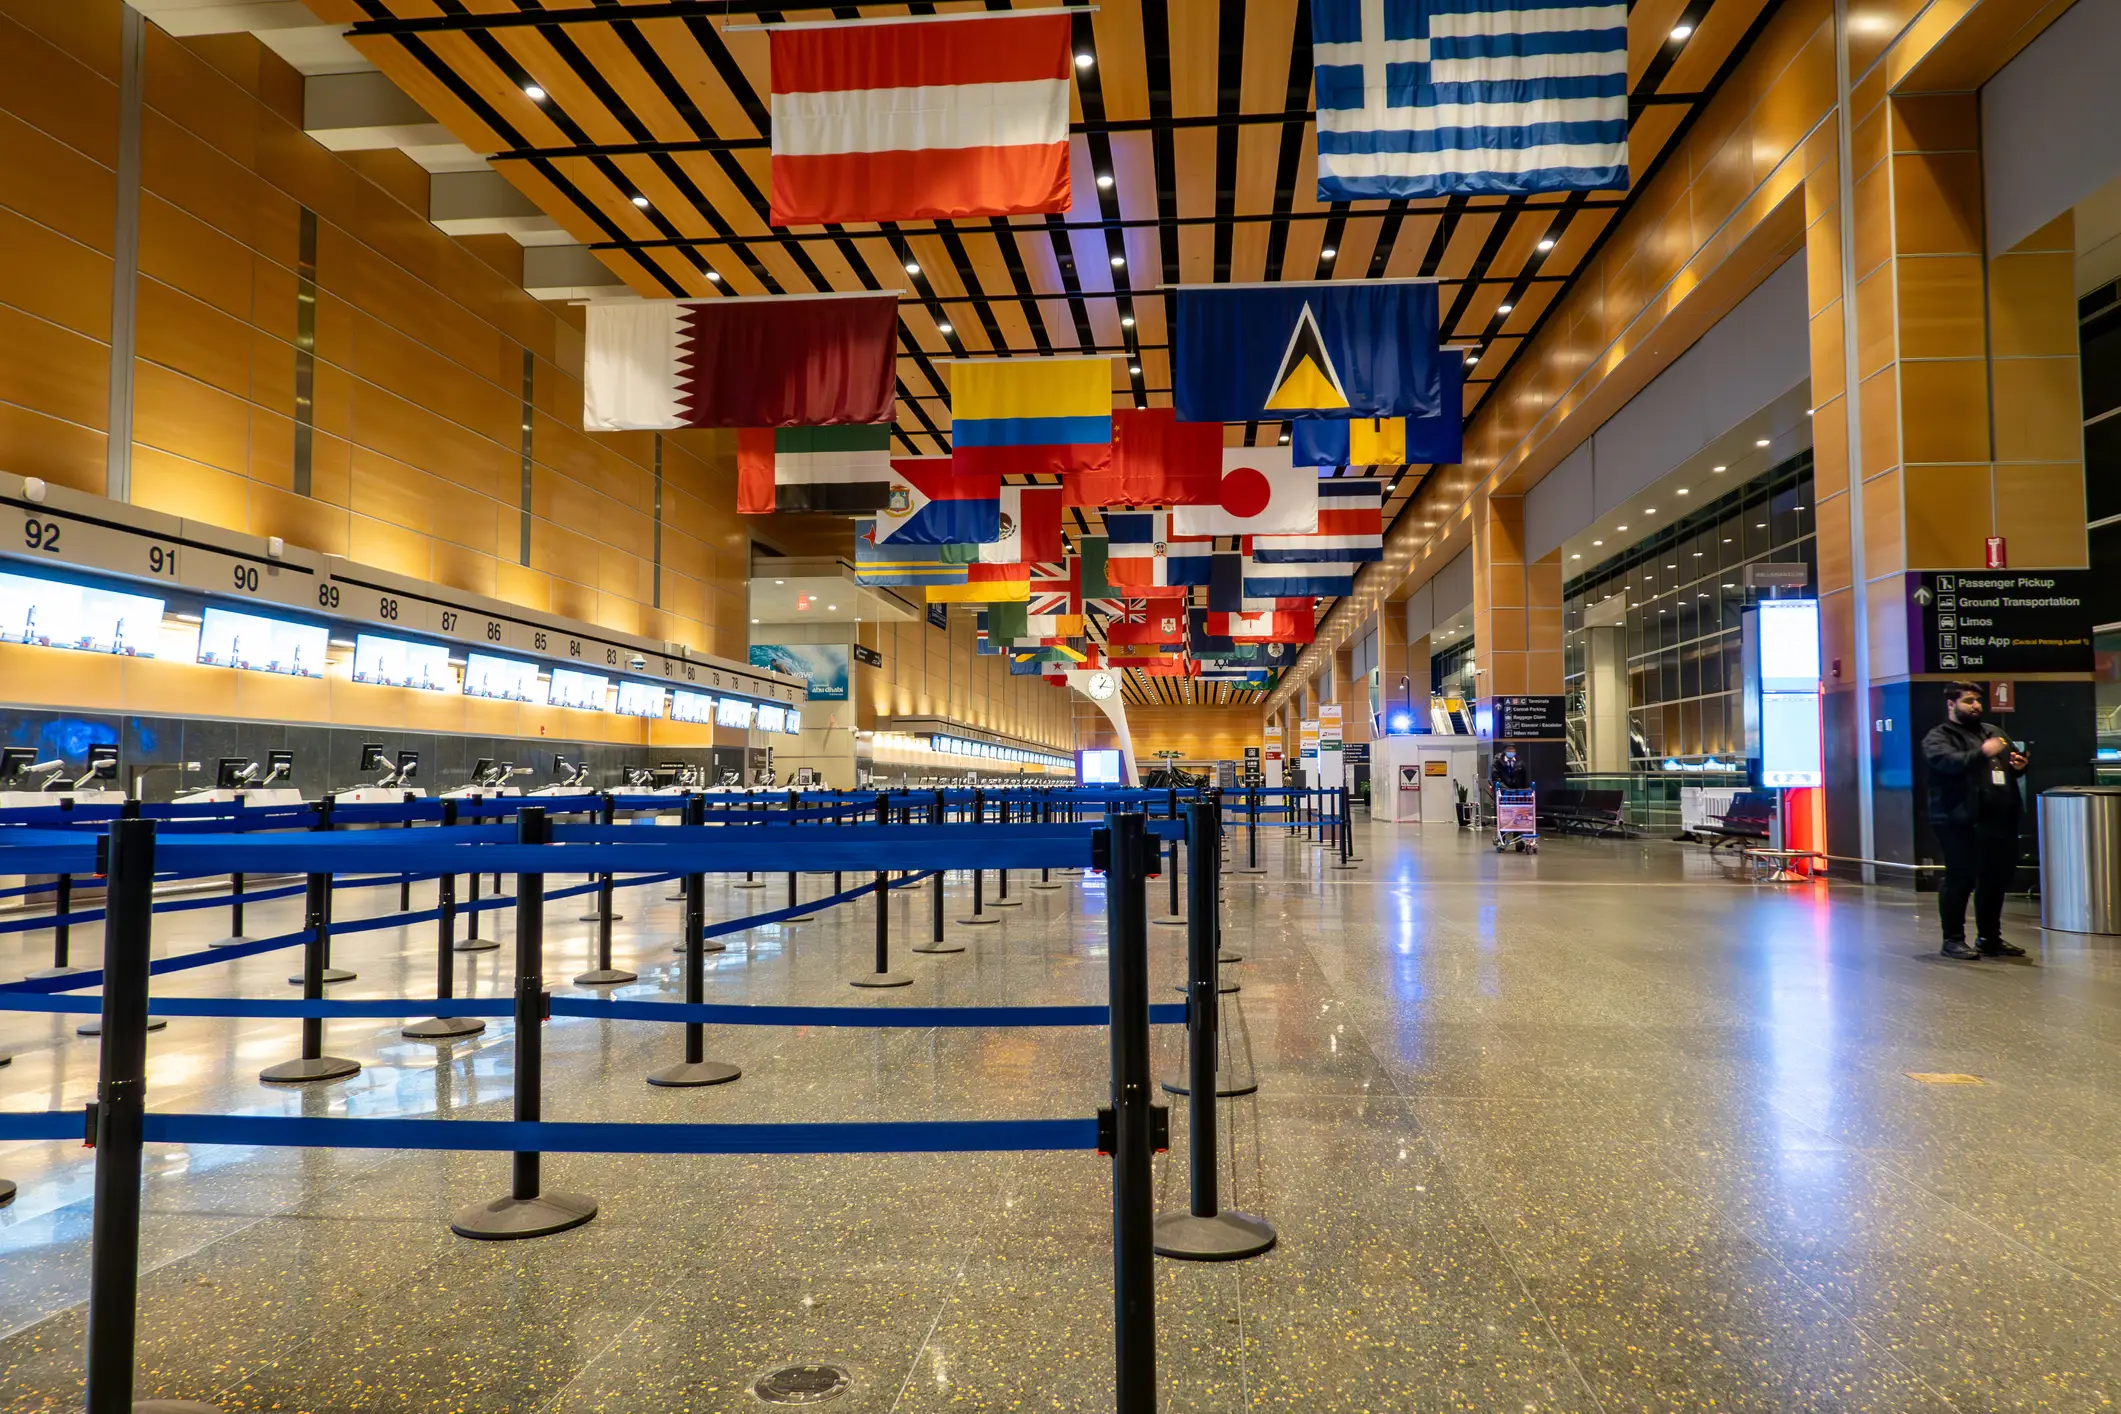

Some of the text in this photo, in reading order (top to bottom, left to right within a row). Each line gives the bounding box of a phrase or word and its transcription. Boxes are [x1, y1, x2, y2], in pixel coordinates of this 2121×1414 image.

[25, 519, 60, 552] 92
[149, 546, 176, 576] 91
[233, 565, 258, 592] 90
[1958, 578, 2055, 590] Passenger Pickup
[318, 584, 340, 608] 89
[1960, 596, 2080, 608] Ground Transportation
[380, 598, 398, 620] 88
[442, 612, 457, 632] 87
[1960, 617, 1993, 626] Limos
[487, 622, 501, 641] 86
[534, 632, 547, 650] 85
[1960, 636, 1985, 646] Ride
[1988, 636, 2011, 648] App
[570, 640, 581, 658] 84
[606, 649, 617, 665] 83
[1961, 655, 1983, 665] Taxi
[665, 662, 673, 676] 81
[688, 667, 695, 681] 80
[712, 673, 720, 686] 79
[732, 676, 739, 689] 78
[753, 682, 759, 693] 77
[787, 689, 792, 700] 75
